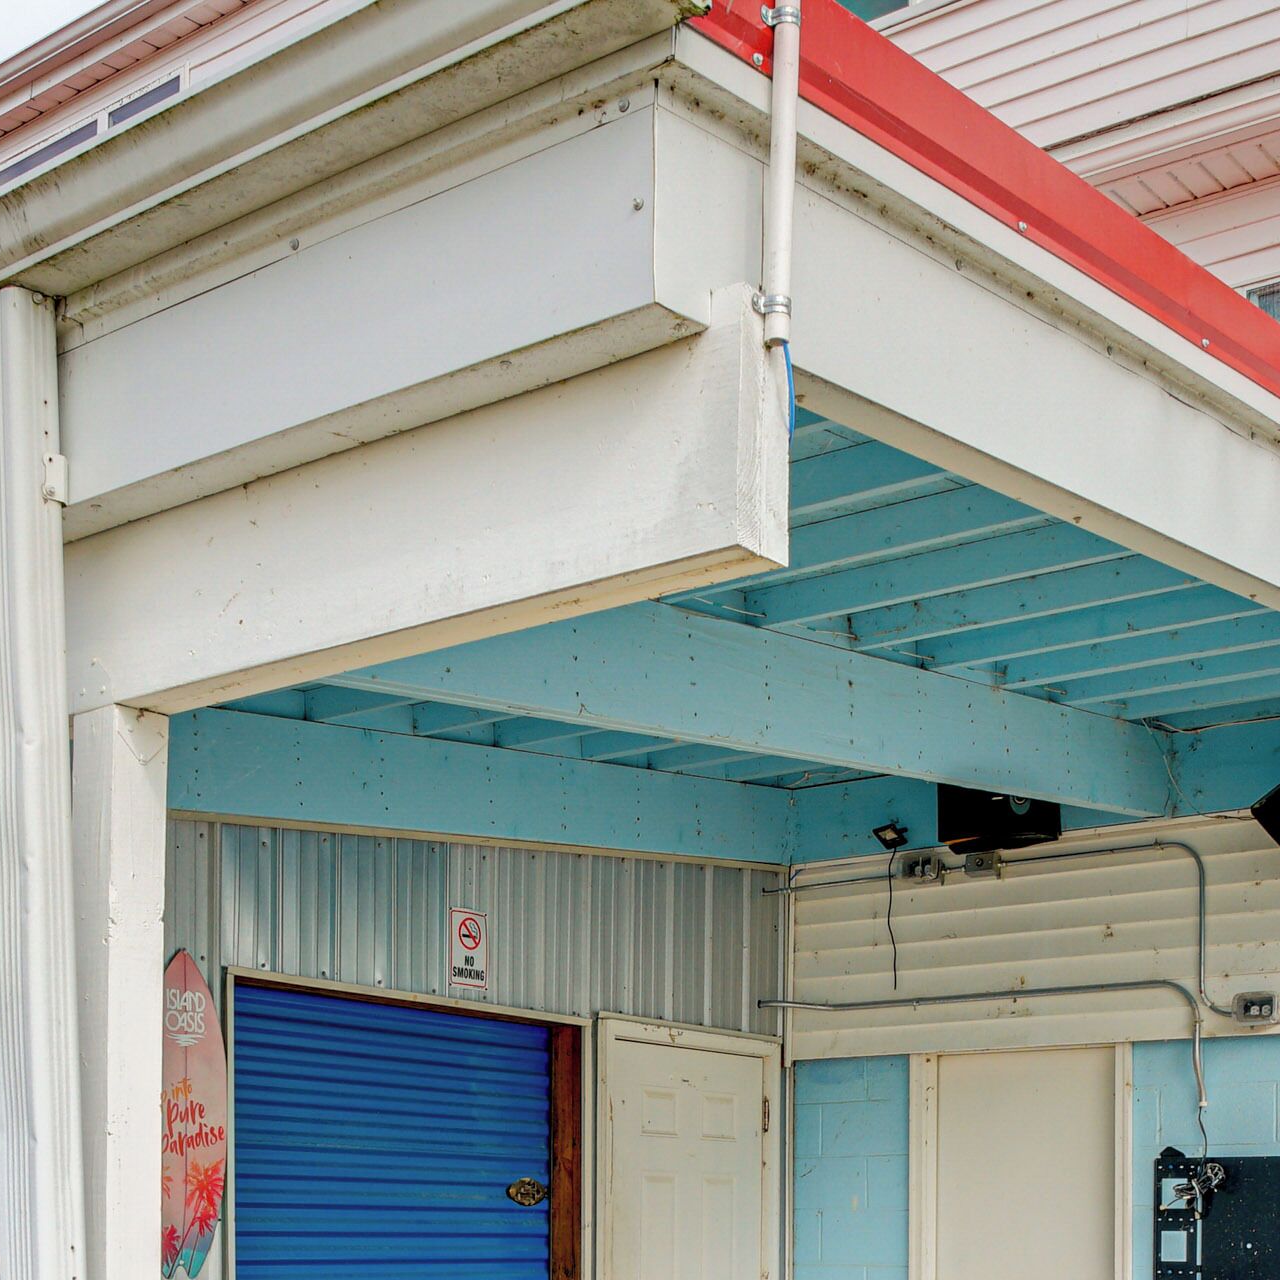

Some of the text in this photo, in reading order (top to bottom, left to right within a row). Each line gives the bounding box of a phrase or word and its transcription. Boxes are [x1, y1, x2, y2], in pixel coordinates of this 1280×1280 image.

[464, 955, 475, 967] NO
[452, 966, 485, 981] SMOKING
[166, 988, 206, 1012] ISLAND
[165, 1009, 206, 1034] OASIS
[171, 1077, 192, 1101] into
